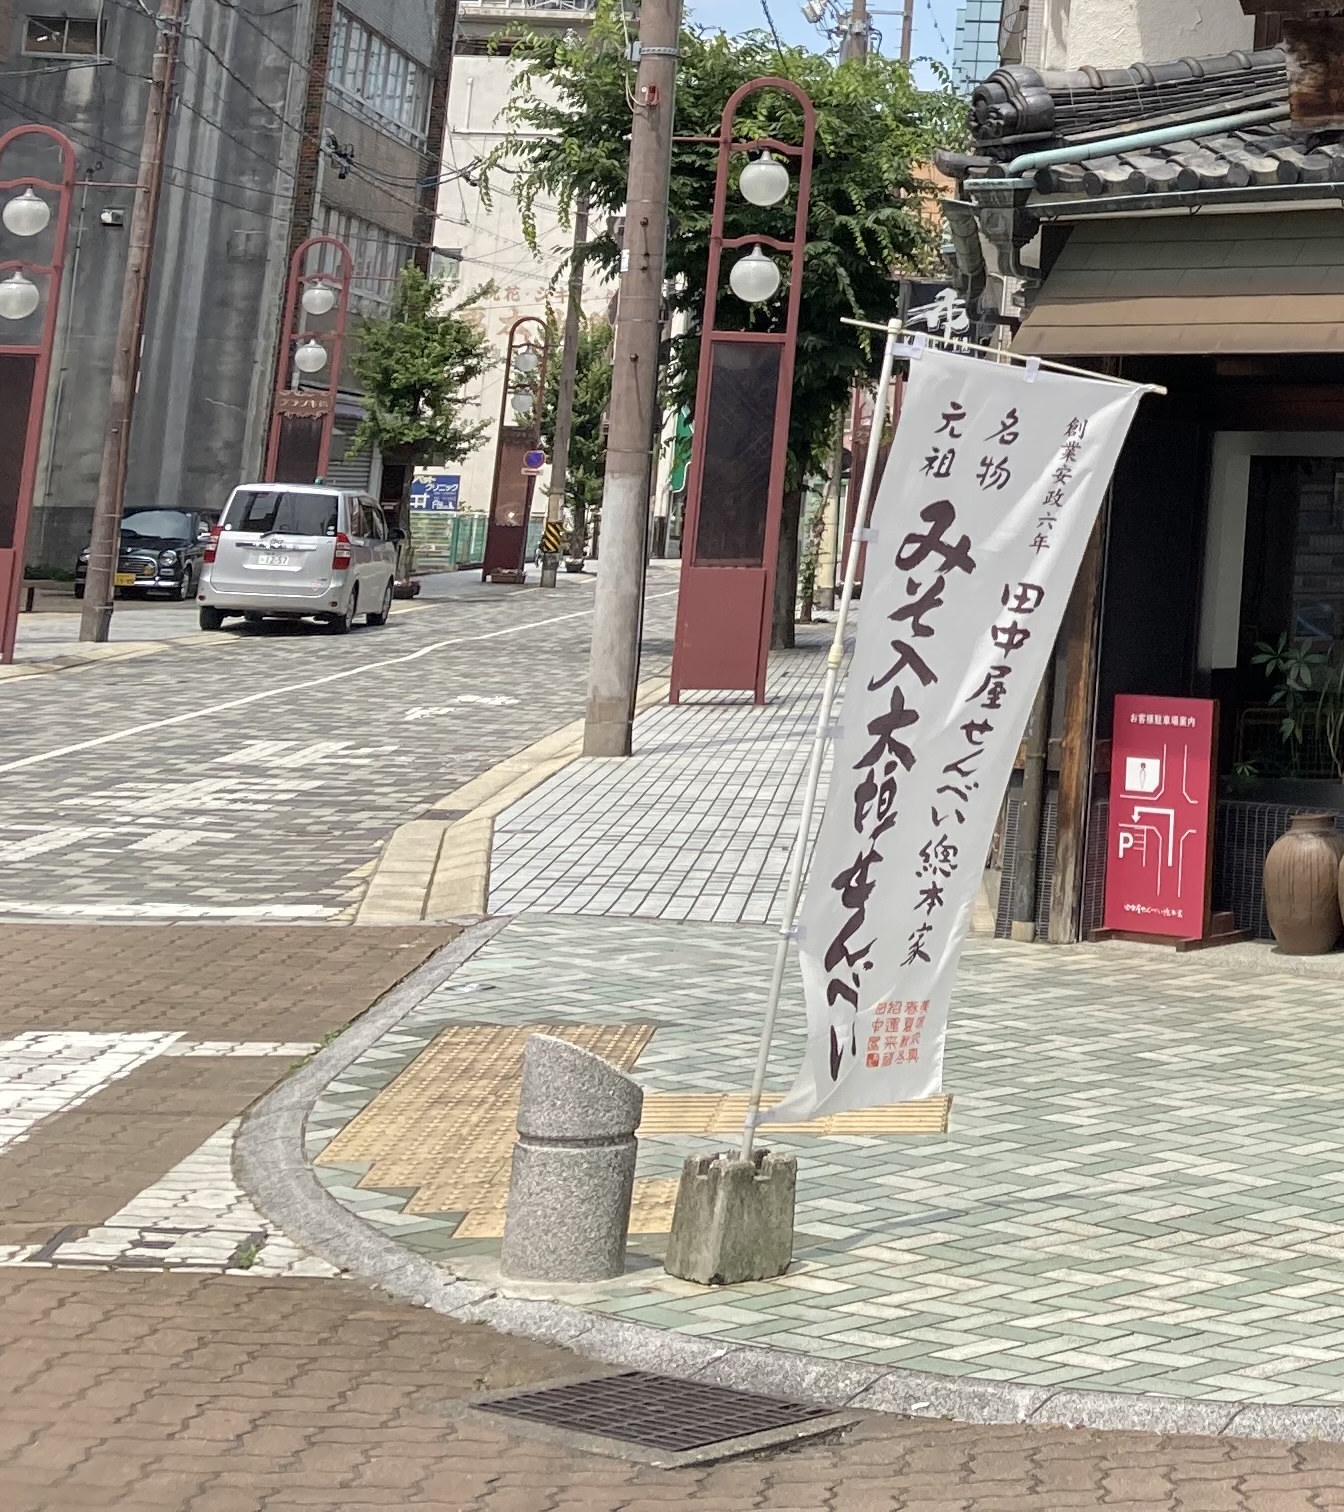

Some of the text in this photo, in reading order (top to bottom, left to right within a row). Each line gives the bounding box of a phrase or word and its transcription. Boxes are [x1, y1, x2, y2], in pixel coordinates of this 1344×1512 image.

[919, 401, 968, 478] 元祖
[975, 408, 1020, 491] 名物
[1027, 416, 1090, 555] 創業安政六年
[1130, 713, 1196, 728] お客様駐車場案内
[1118, 832, 1134, 858] P
